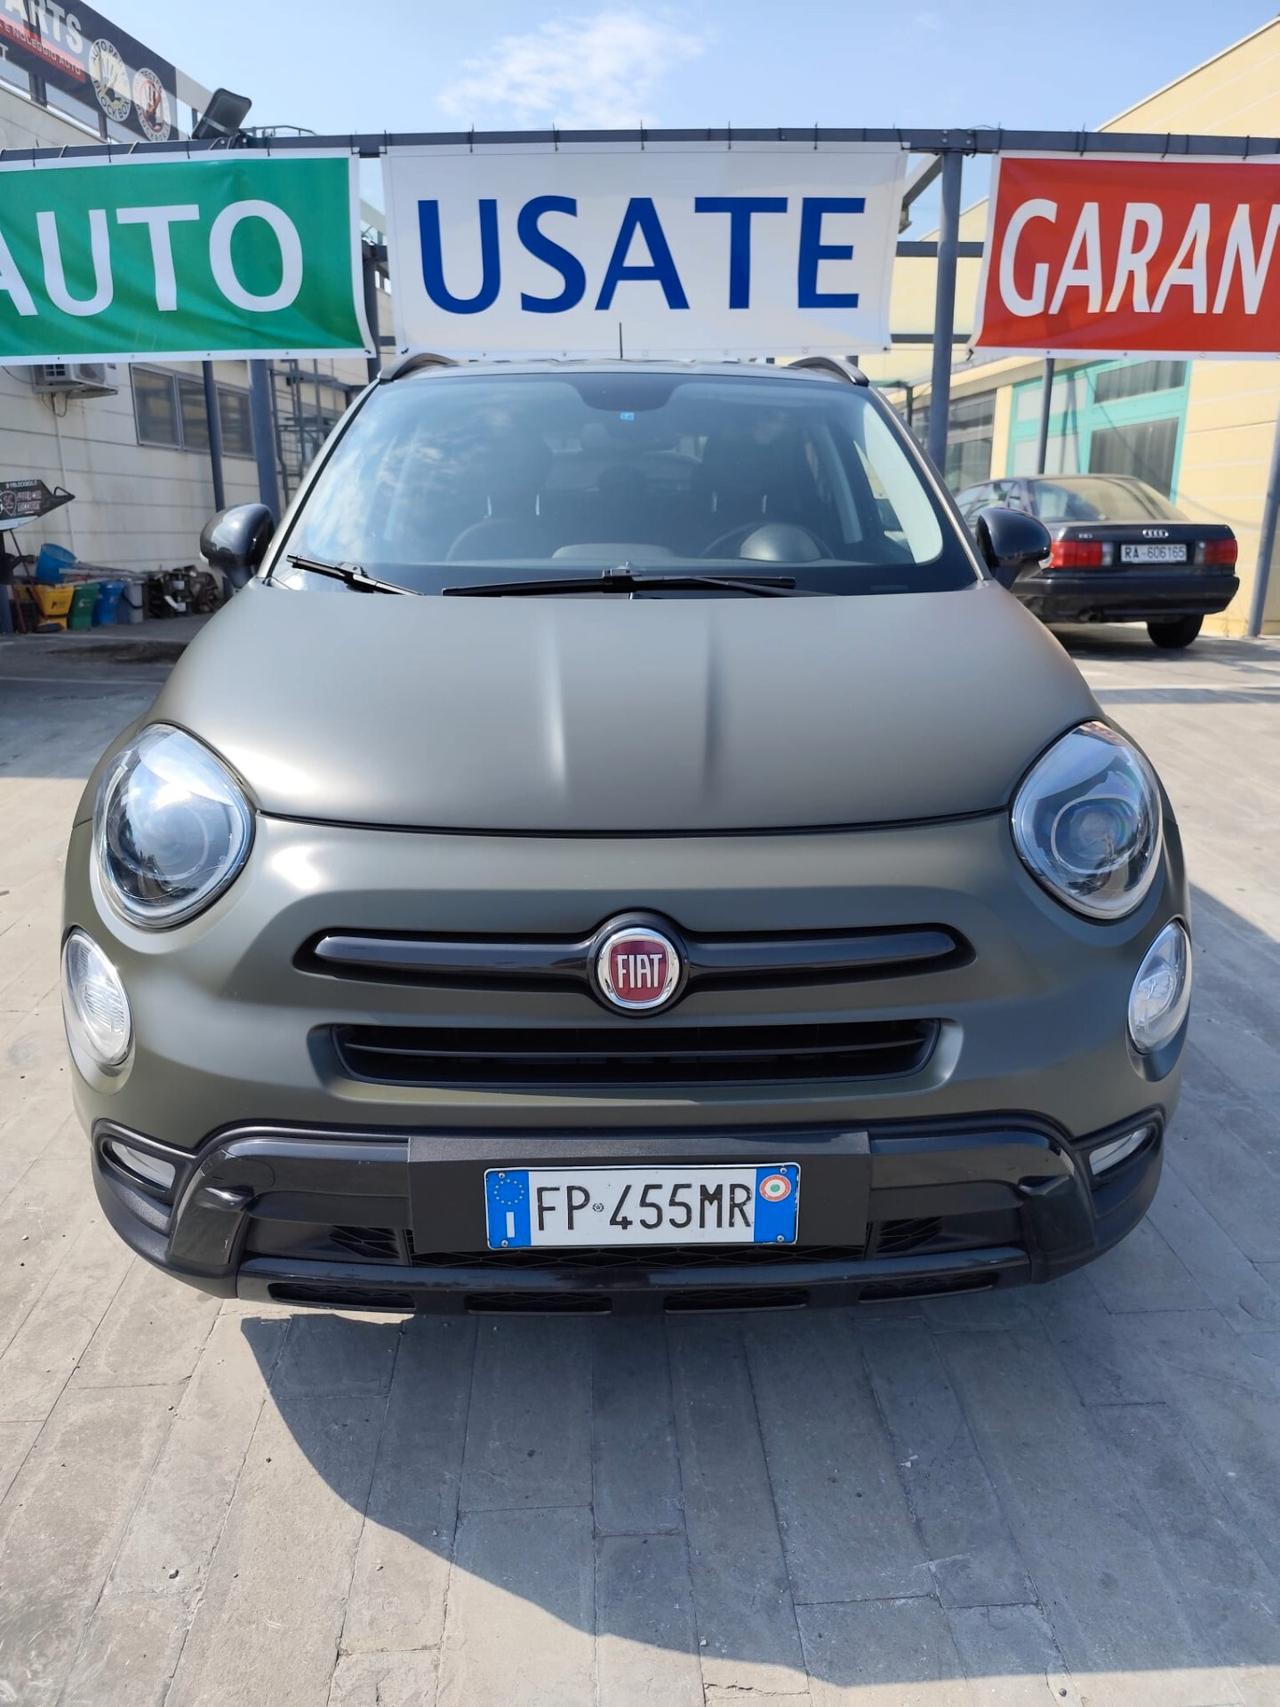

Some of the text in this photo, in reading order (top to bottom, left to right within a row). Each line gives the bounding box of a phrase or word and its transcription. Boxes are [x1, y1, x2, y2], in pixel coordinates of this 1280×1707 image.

[417, 195, 867, 315] USATE
[1000, 198, 1280, 317] GARAN
[616, 953, 663, 989] FIAT
